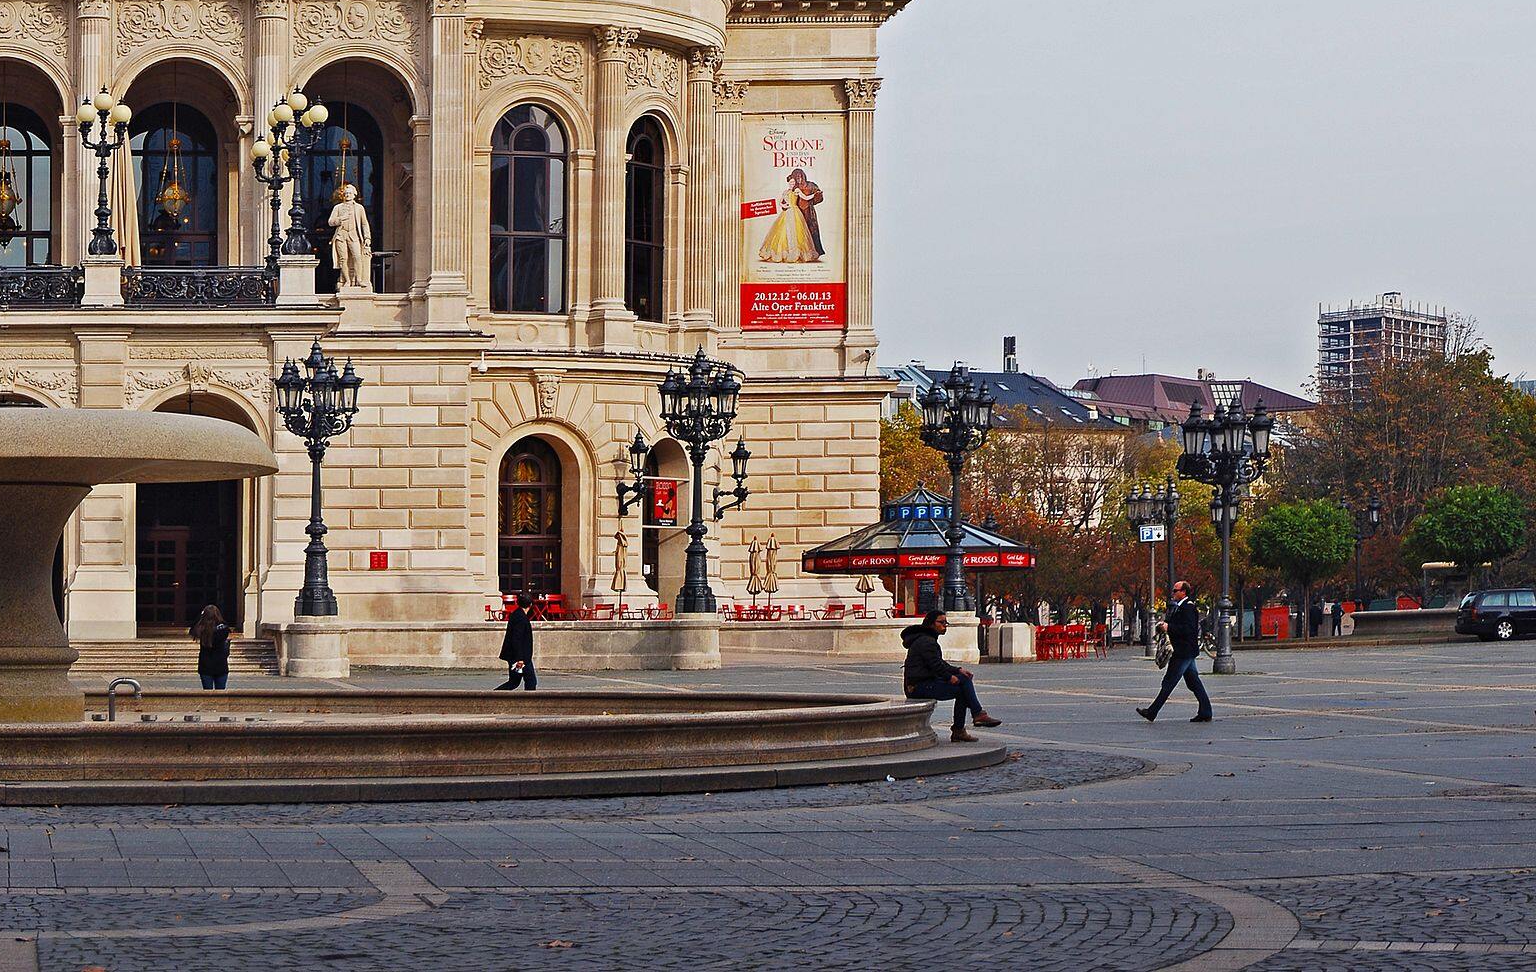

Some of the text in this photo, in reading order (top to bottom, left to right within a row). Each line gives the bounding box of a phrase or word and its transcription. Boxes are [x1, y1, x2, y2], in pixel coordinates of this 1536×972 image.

[774, 152, 816, 167] BIEST
[797, 292, 831, 300] 06.01.13
[751, 302, 835, 313] Alte Oper Frankfurt
